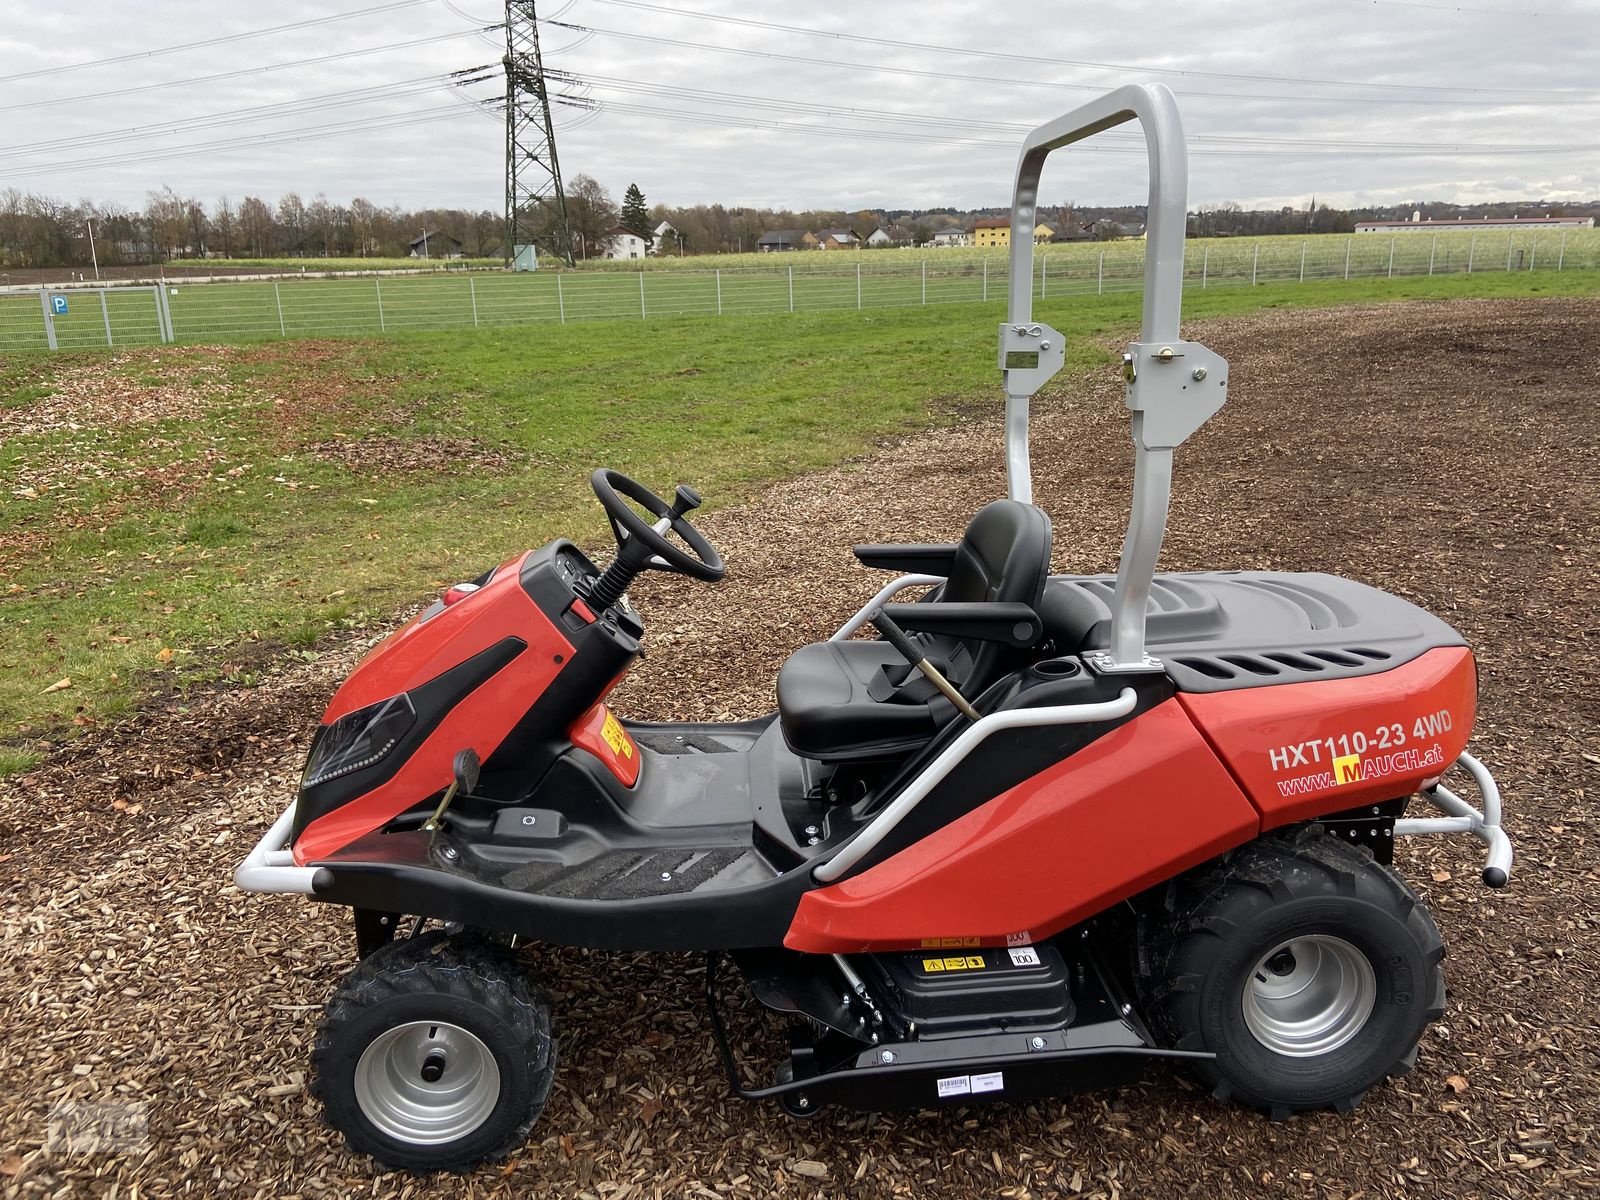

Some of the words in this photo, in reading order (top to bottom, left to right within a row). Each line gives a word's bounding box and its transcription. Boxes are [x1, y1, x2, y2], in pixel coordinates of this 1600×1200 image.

[54, 297, 65, 313] P
[1269, 724, 1406, 771] HXT110-23
[1413, 709, 1452, 740] 4WD
